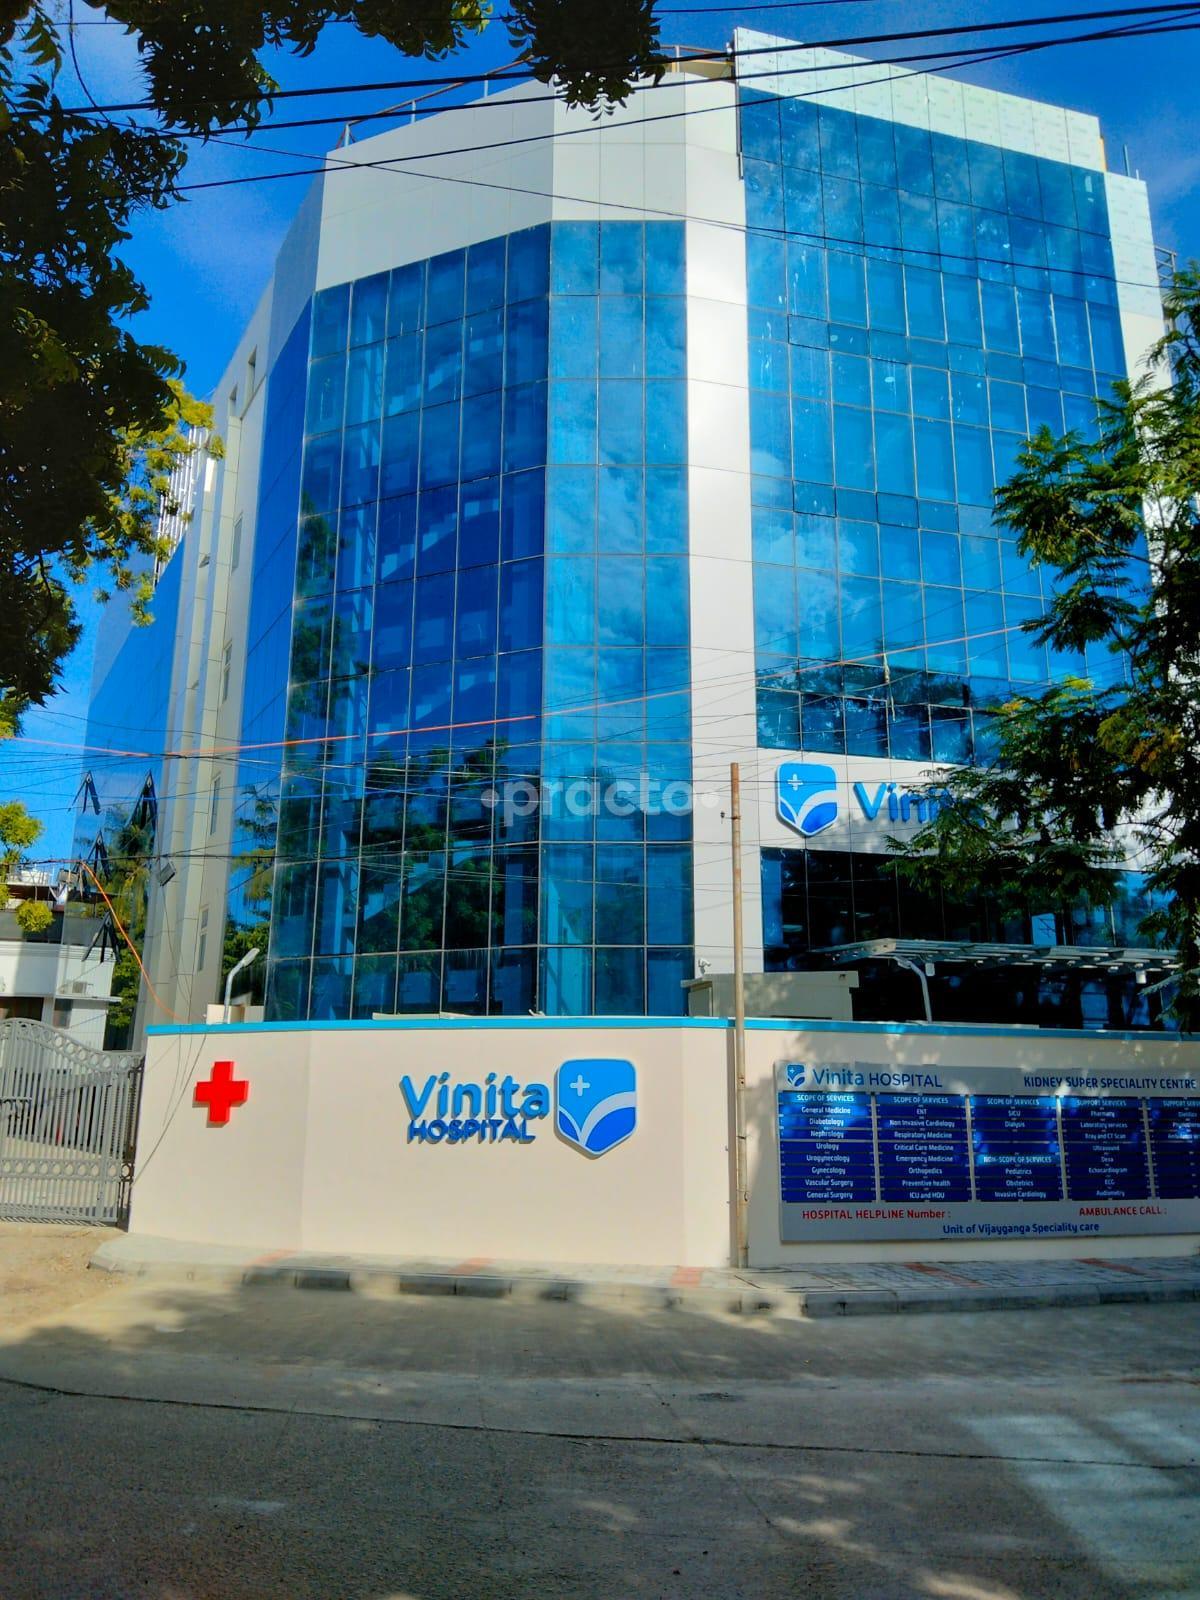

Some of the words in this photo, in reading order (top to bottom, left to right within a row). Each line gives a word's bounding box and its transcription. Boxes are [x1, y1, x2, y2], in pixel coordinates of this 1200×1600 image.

[812, 1068, 864, 1086] Vinita
[869, 1073, 943, 1087] HOSPITAL
[1024, 1076, 1062, 1088] KIDNEY
[1065, 1077, 1098, 1088] SUPER
[1101, 1077, 1158, 1089] SPECIALITY
[1160, 1078, 1196, 1089] CENTRE
[399, 1071, 550, 1120] Vinita
[926, 1120, 955, 1128] Cardiology
[407, 1119, 536, 1144] HOSPITAL
[810, 1130, 844, 1138] Nephrology
[894, 1132, 926, 1140] Respiratory
[816, 1142, 840, 1150] Urology
[806, 1154, 850, 1162] Urogynecology
[896, 1155, 928, 1163] Emergency
[812, 1166, 846, 1174] Gynecology
[830, 1179, 854, 1187] Surgery
[830, 1192, 853, 1200] Surgery
[802, 1209, 853, 1219] HOSPITAL
[856, 1209, 904, 1219] HELPLINE
[907, 1210, 945, 1219] Number
[1079, 1206, 1137, 1216] AMBULANCE
[1139, 1206, 1162, 1216] CALL
[943, 1224, 964, 1234] Unit
[966, 1224, 976, 1234] of
[978, 1224, 1030, 1235] Vijayganga
[1032, 1222, 1078, 1234] Speciality
[1080, 1223, 1099, 1232] care
